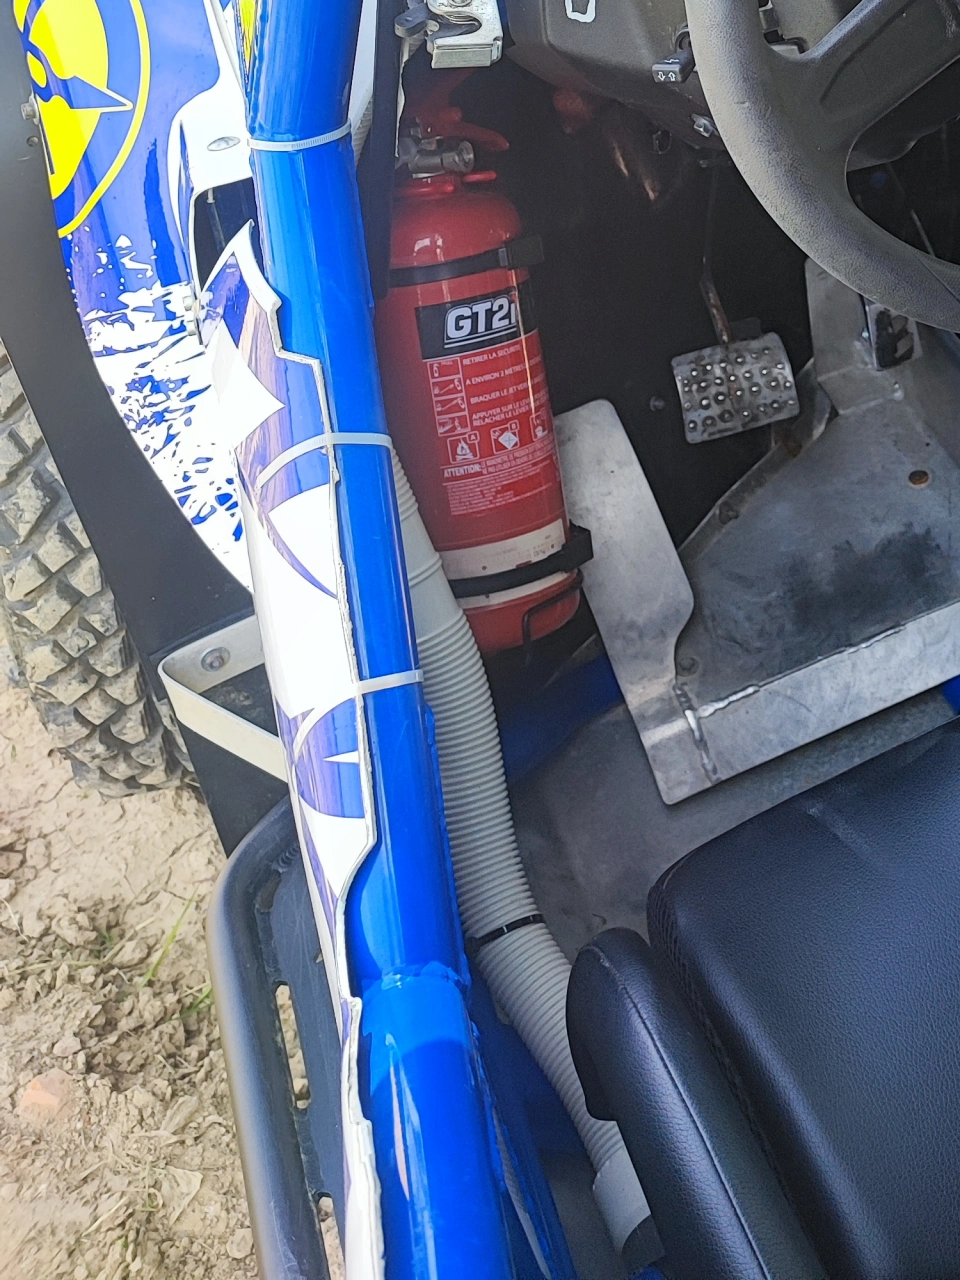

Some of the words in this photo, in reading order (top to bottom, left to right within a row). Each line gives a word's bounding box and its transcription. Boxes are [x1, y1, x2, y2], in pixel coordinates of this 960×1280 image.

[446, 294, 516, 339] GT2i
[463, 354, 488, 365] RETIRER
[489, 352, 497, 360] LA
[472, 371, 499, 384] ENVIRON
[471, 391, 500, 404] BRAQUER
[501, 388, 508, 397] LE
[472, 407, 500, 420] APPUYER
[502, 402, 513, 412] SUR
[473, 413, 504, 426] RELACHER
[505, 409, 512, 418] LE
[444, 462, 482, 478] ATTENTION:
